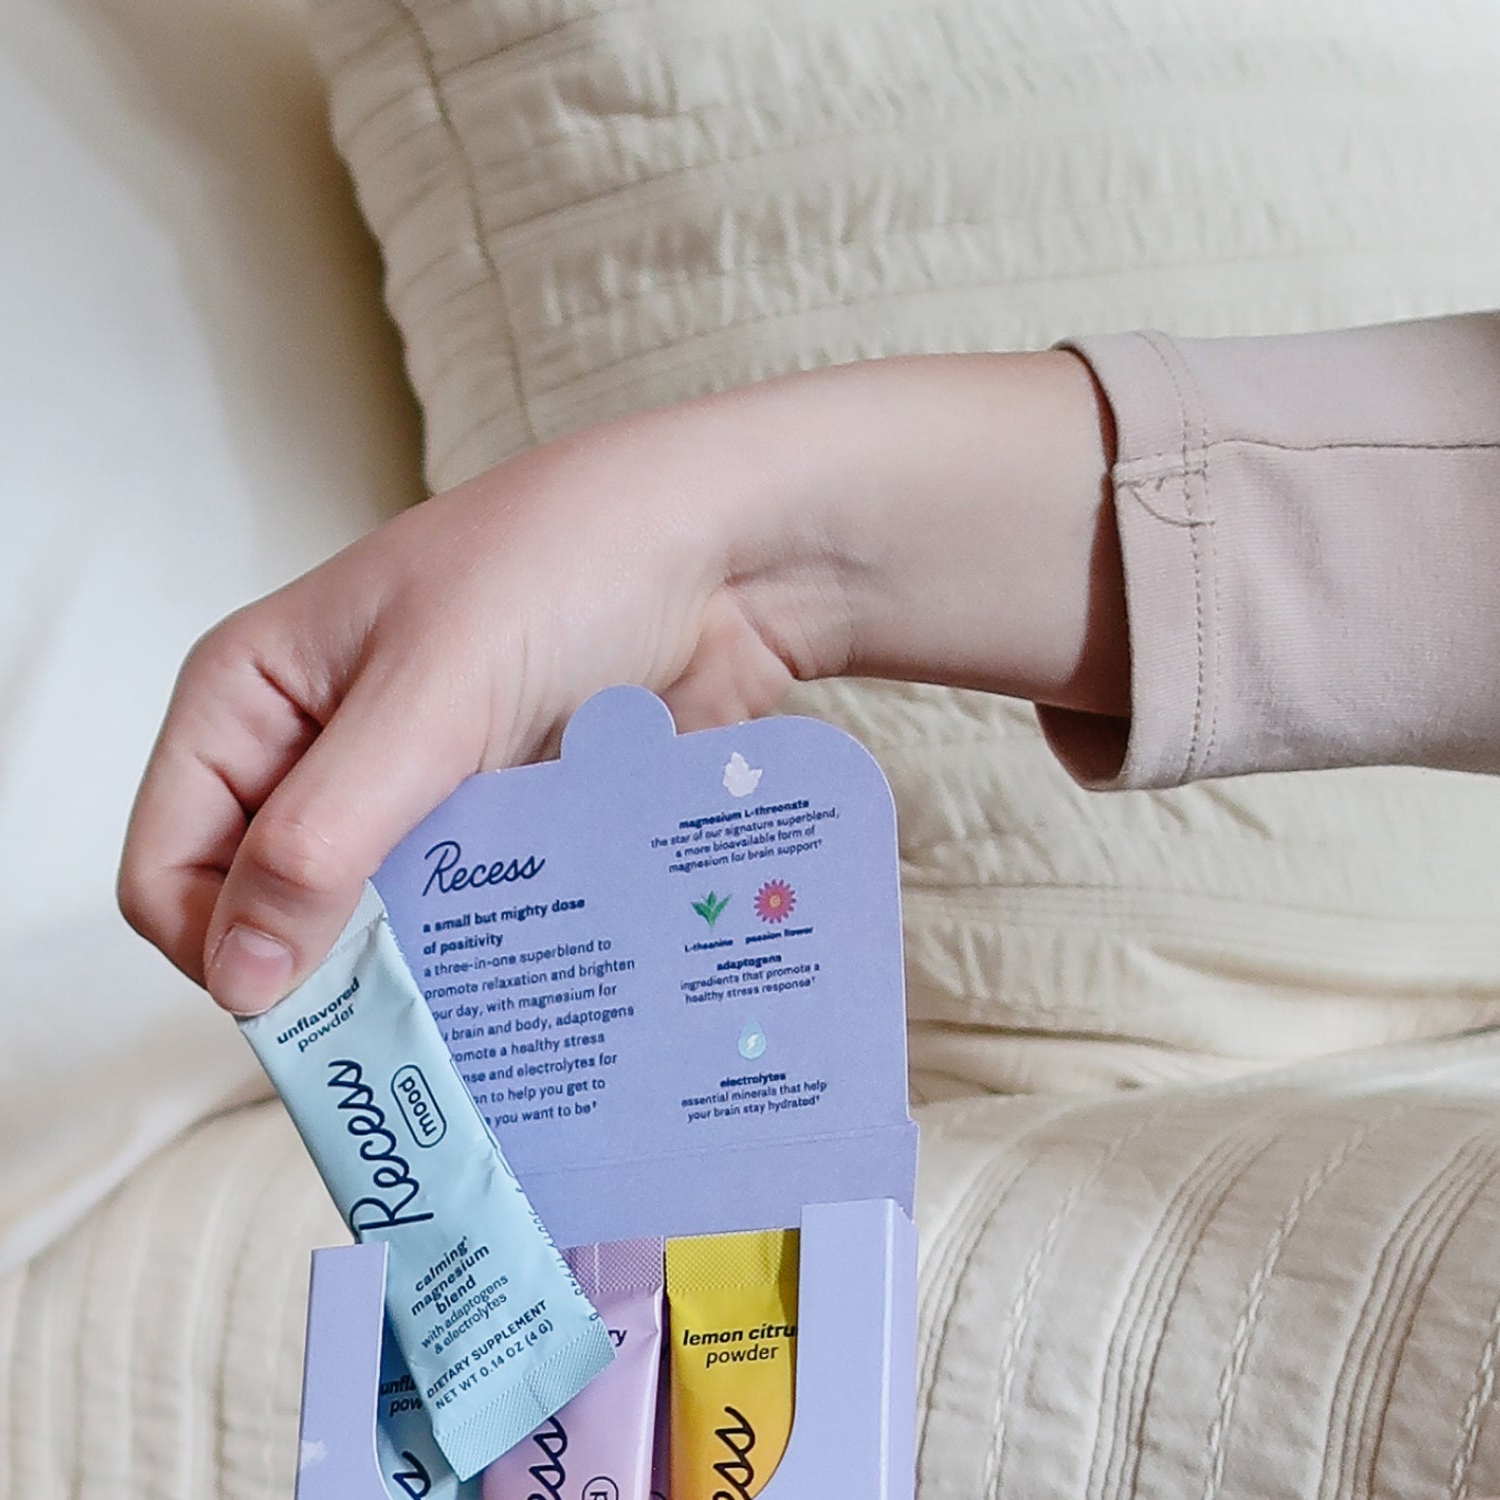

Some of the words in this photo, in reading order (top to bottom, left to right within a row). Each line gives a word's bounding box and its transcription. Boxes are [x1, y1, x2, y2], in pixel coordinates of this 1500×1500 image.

[651, 837, 668, 848] the
[671, 834, 690, 845] star
[693, 830, 703, 841] of
[705, 829, 722, 839] our
[724, 820, 774, 837] signature
[679, 812, 742, 830] magnesium
[684, 845, 711, 856] more
[713, 833, 775, 852] bioavailable
[778, 830, 802, 842] form
[805, 825, 816, 836] of
[422, 840, 545, 896] Recess
[669, 856, 729, 874] magnesium
[731, 852, 745, 863] for
[748, 847, 774, 860] brain
[423, 923, 431, 933] a
[435, 914, 471, 931] small
[475, 912, 497, 925] but
[501, 904, 548, 921] mighty
[551, 899, 585, 912] dose
[423, 942, 436, 955] of
[440, 933, 503, 955] positivity
[424, 968, 431, 977] a
[435, 954, 516, 976] three-in-one
[520, 940, 594, 963] superblend
[598, 938, 611, 950] to
[482, 972, 547, 991] relaxation
[551, 966, 575, 981] and
[579, 959, 635, 978] brighten
[681, 975, 739, 991] ingredients
[742, 970, 763, 982] that
[766, 964, 811, 980] promote
[717, 955, 782, 971] adaptogens
[276, 975, 359, 1045] unflavored
[432, 1008, 453, 1021] our
[456, 1004, 483, 1019] day,
[486, 998, 515, 1013] with
[519, 988, 595, 1008] magnesium
[599, 984, 617, 997] for
[685, 990, 724, 1004] healthy
[727, 986, 759, 998] stress
[297, 1003, 355, 1054] powder
[452, 1025, 484, 1041] brain
[488, 1021, 511, 1035] and
[515, 1017, 552, 1032] body,
[556, 1005, 634, 1026] adaptogens
[452, 1047, 496, 1062] omote
[500, 1046, 507, 1056] a
[511, 1037, 560, 1056] healthy
[564, 1033, 604, 1047] stress
[489, 1066, 513, 1080] and
[517, 1057, 595, 1076] electrolytes
[599, 1052, 617, 1066] for
[720, 1072, 787, 1087] electrolytes
[397, 1075, 438, 1137] mood
[491, 1092, 504, 1103] to
[508, 1086, 536, 1101] help
[540, 1084, 563, 1100] you
[567, 1080, 588, 1096] get
[592, 1079, 605, 1090] to
[681, 1094, 729, 1108] essential
[731, 1087, 777, 1101] minerals
[780, 1083, 801, 1095] that
[804, 1080, 827, 1092] help
[495, 1113, 518, 1128] you
[522, 1107, 554, 1122] want
[558, 1106, 571, 1117] to
[687, 1110, 711, 1123] your
[713, 1105, 741, 1117] brain
[743, 1103, 766, 1115] stay
[328, 1059, 434, 1244] Recess
[411, 1245, 490, 1316] magnesium
[435, 1274, 476, 1315] blend
[421, 1325, 445, 1349] with
[444, 1275, 509, 1330] adaptogens
[434, 1342, 444, 1355] &
[443, 1293, 507, 1347] electrolytes
[426, 1356, 471, 1399] DIETARY
[471, 1299, 548, 1362] SUPPLEMENT
[682, 1329, 743, 1346] lemon
[748, 1323, 798, 1341] citru
[435, 1388, 458, 1410] NET
[458, 1373, 479, 1392] WT
[479, 1355, 505, 1377] 0.14
[505, 1341, 525, 1358] OZ
[524, 1330, 538, 1347] (4
[538, 1318, 554, 1335] G)
[706, 1344, 779, 1368] powder
